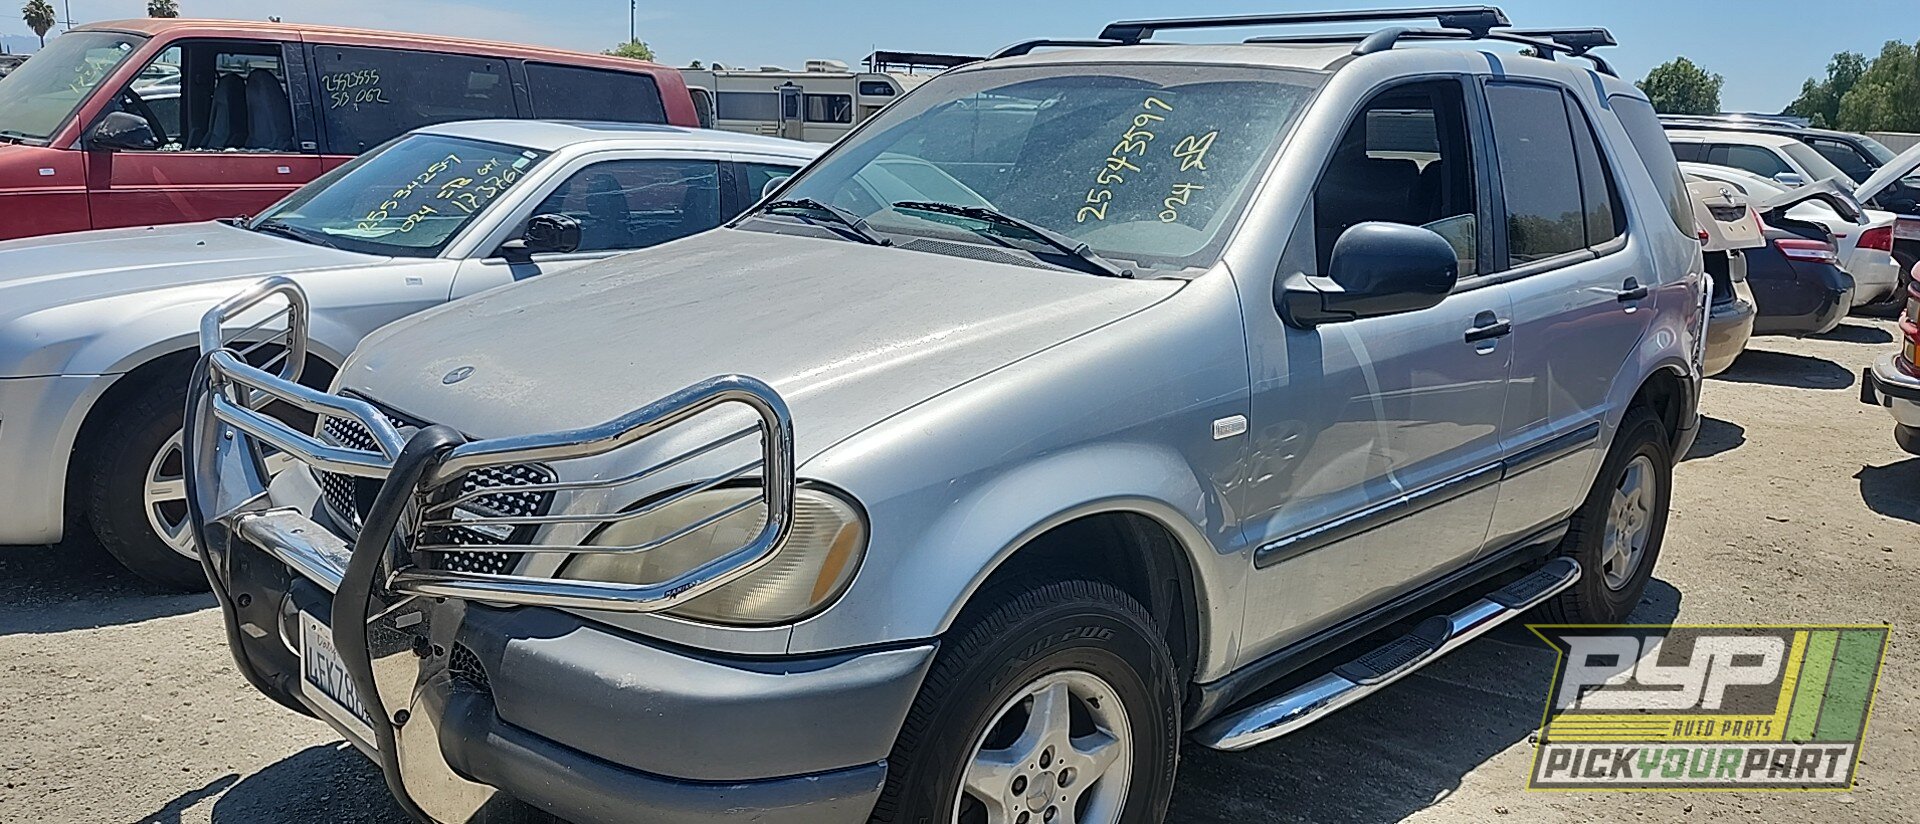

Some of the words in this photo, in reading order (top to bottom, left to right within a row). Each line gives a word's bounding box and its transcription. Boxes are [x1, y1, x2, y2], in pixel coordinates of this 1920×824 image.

[1076, 97, 1173, 223] 25543597
[399, 205, 438, 233] 024
[1159, 182, 1204, 223] 024
